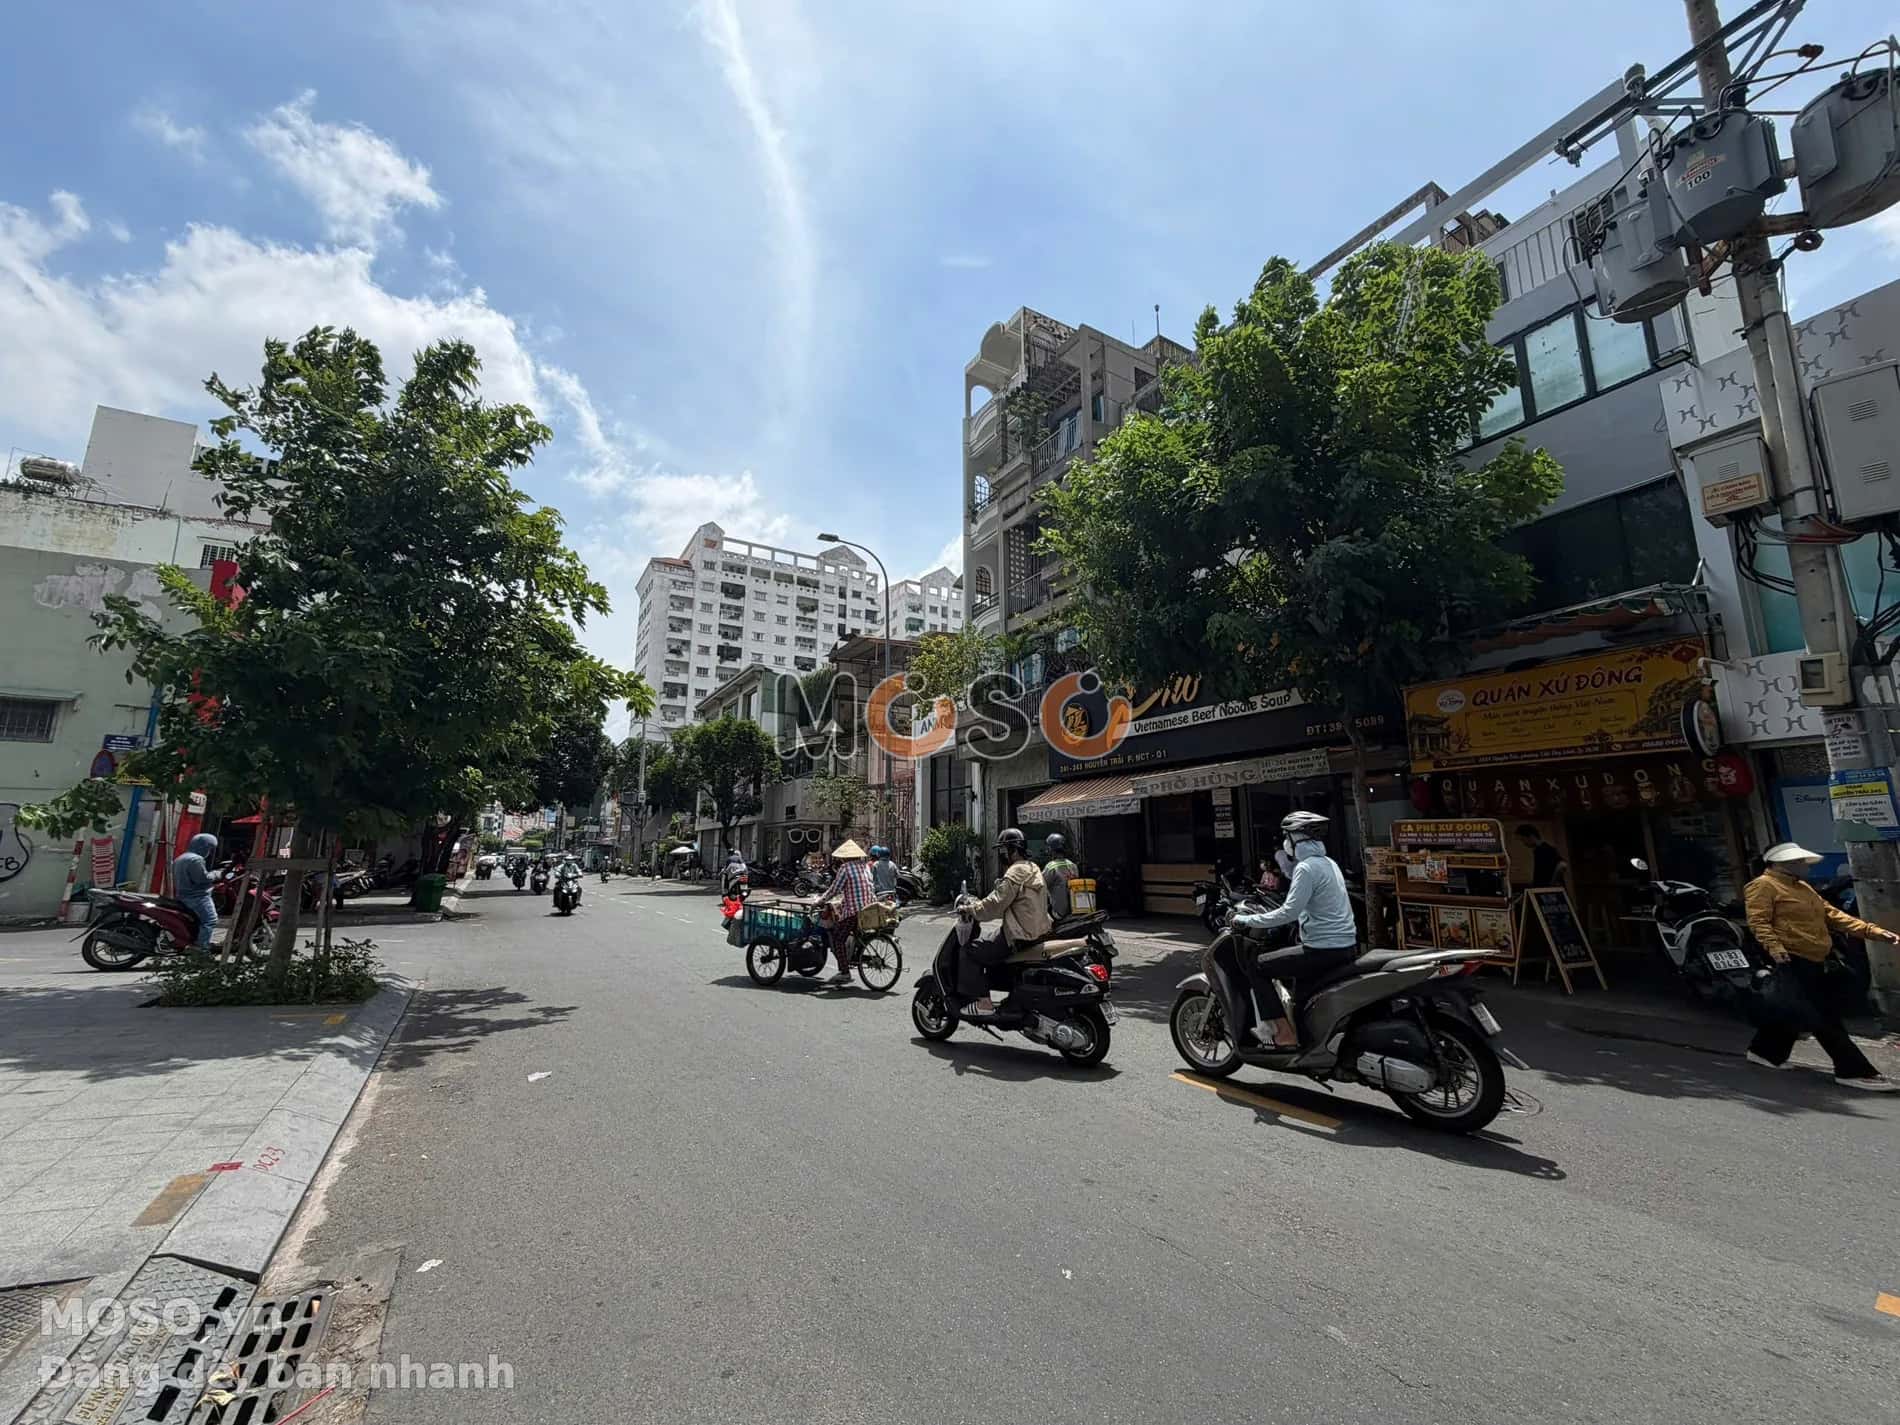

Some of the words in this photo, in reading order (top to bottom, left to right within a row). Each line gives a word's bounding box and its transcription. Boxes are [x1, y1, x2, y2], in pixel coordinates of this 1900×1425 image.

[1688, 171, 1710, 188] 100
[1473, 680, 1530, 706] QUÁN
[1539, 672, 1570, 697] XỨ
[1575, 666, 1642, 691] ĐÔNG
[1134, 714, 1189, 733] Vietnamese
[1192, 708, 1216, 722] Beef
[1261, 694, 1292, 709] Soup
[1194, 769, 1257, 790] HÙNG
